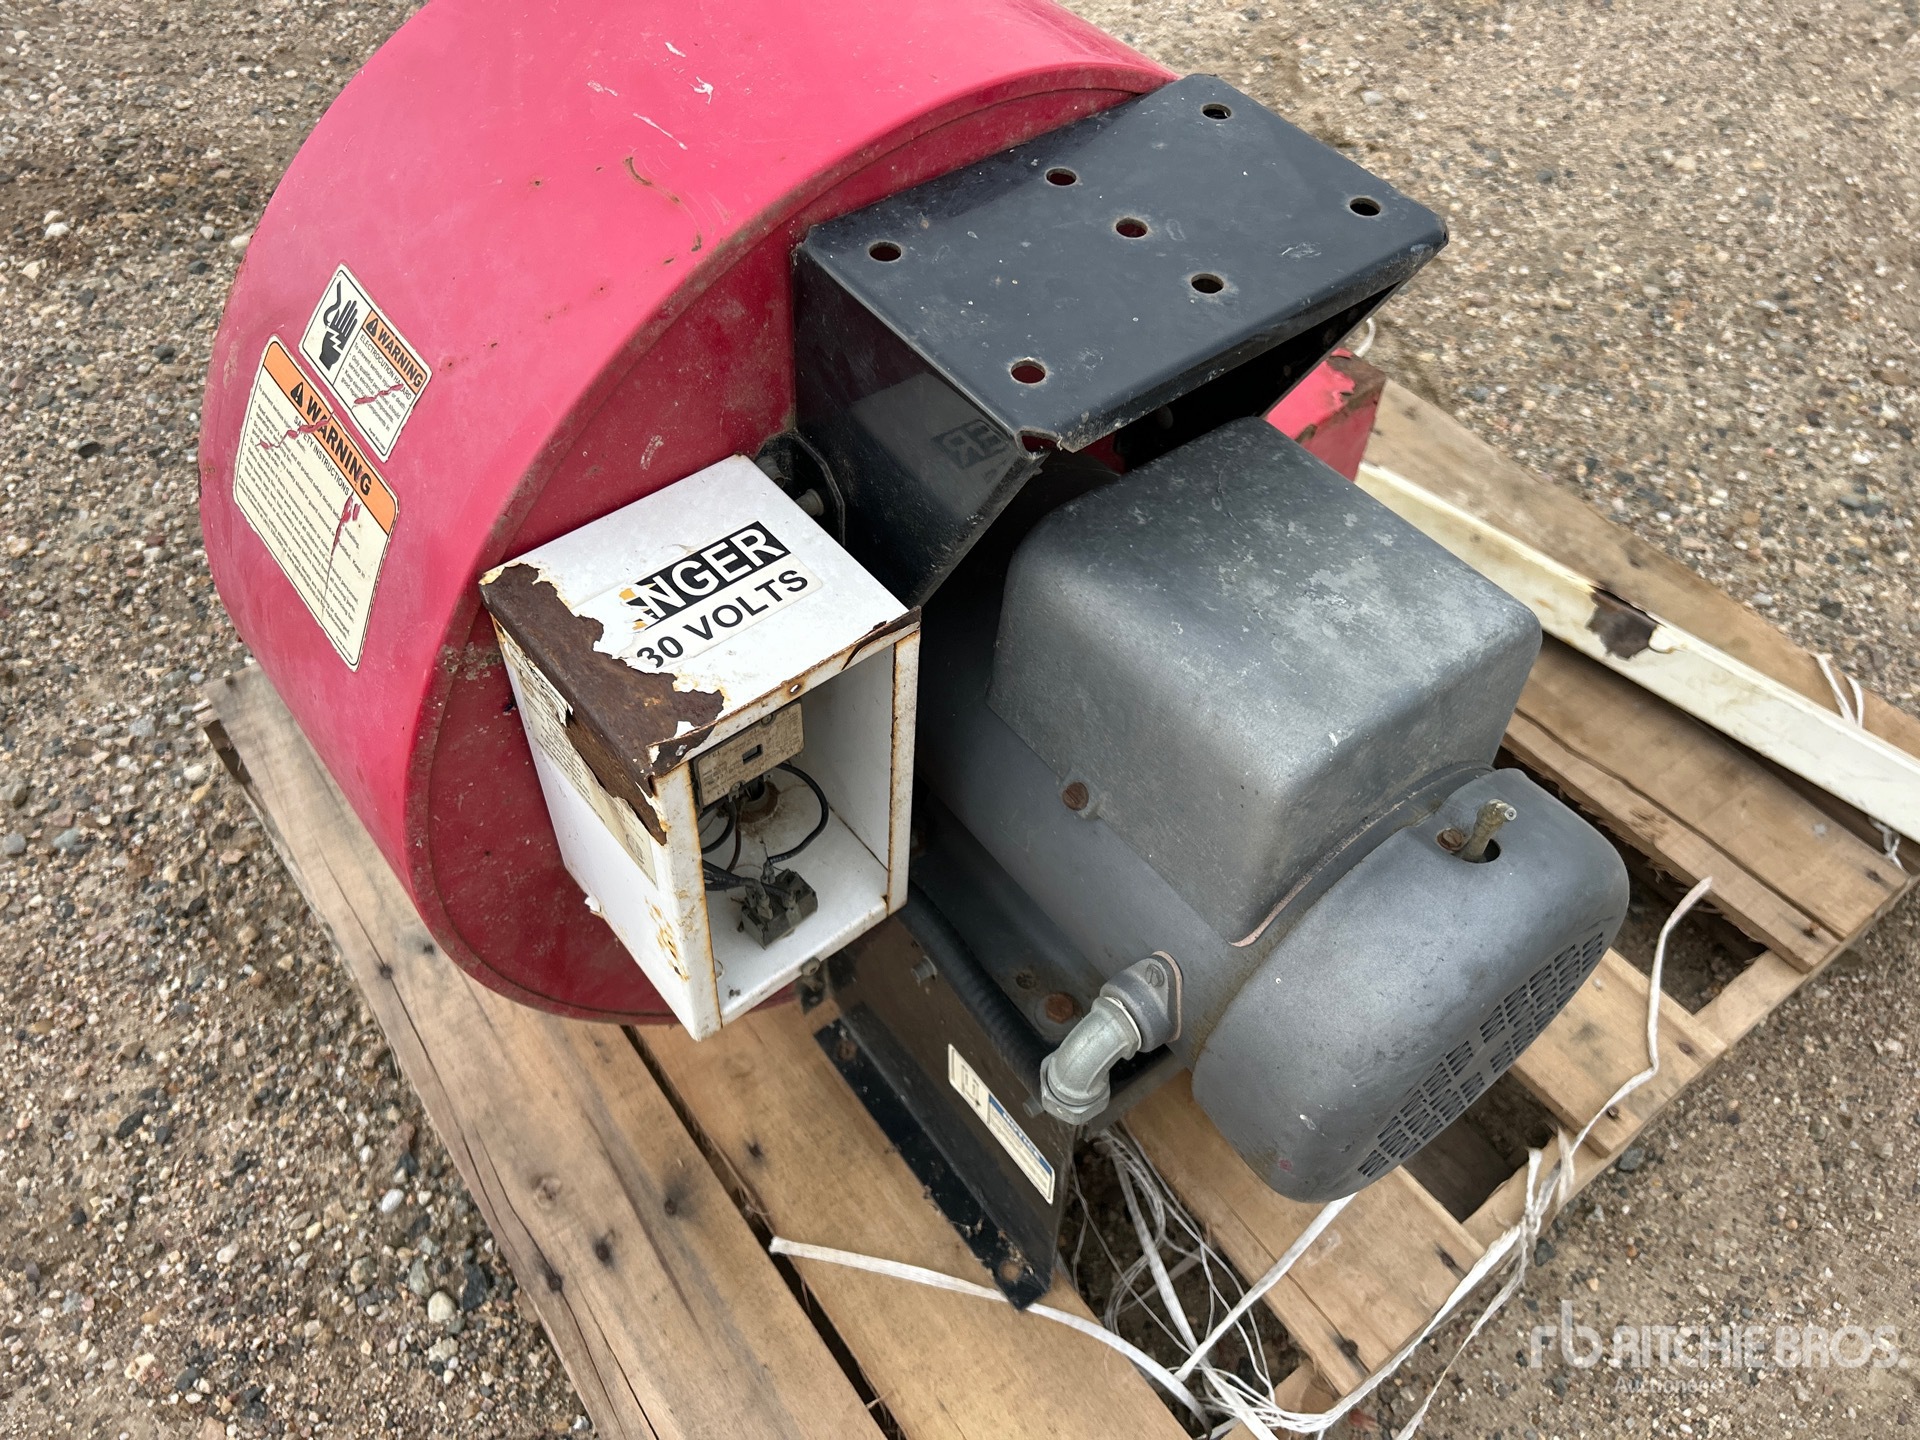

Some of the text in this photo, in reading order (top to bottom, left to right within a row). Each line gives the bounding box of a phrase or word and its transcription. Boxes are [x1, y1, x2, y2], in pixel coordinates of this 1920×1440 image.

[359, 332, 412, 401] ELECTROCUTION HAARD
[376, 326, 424, 389] WARNING
[304, 393, 374, 499] WARNING
[312, 442, 350, 497] INSTRUCTIONS
[640, 528, 786, 620] NGER
[636, 569, 808, 669] 30 VOLTS
